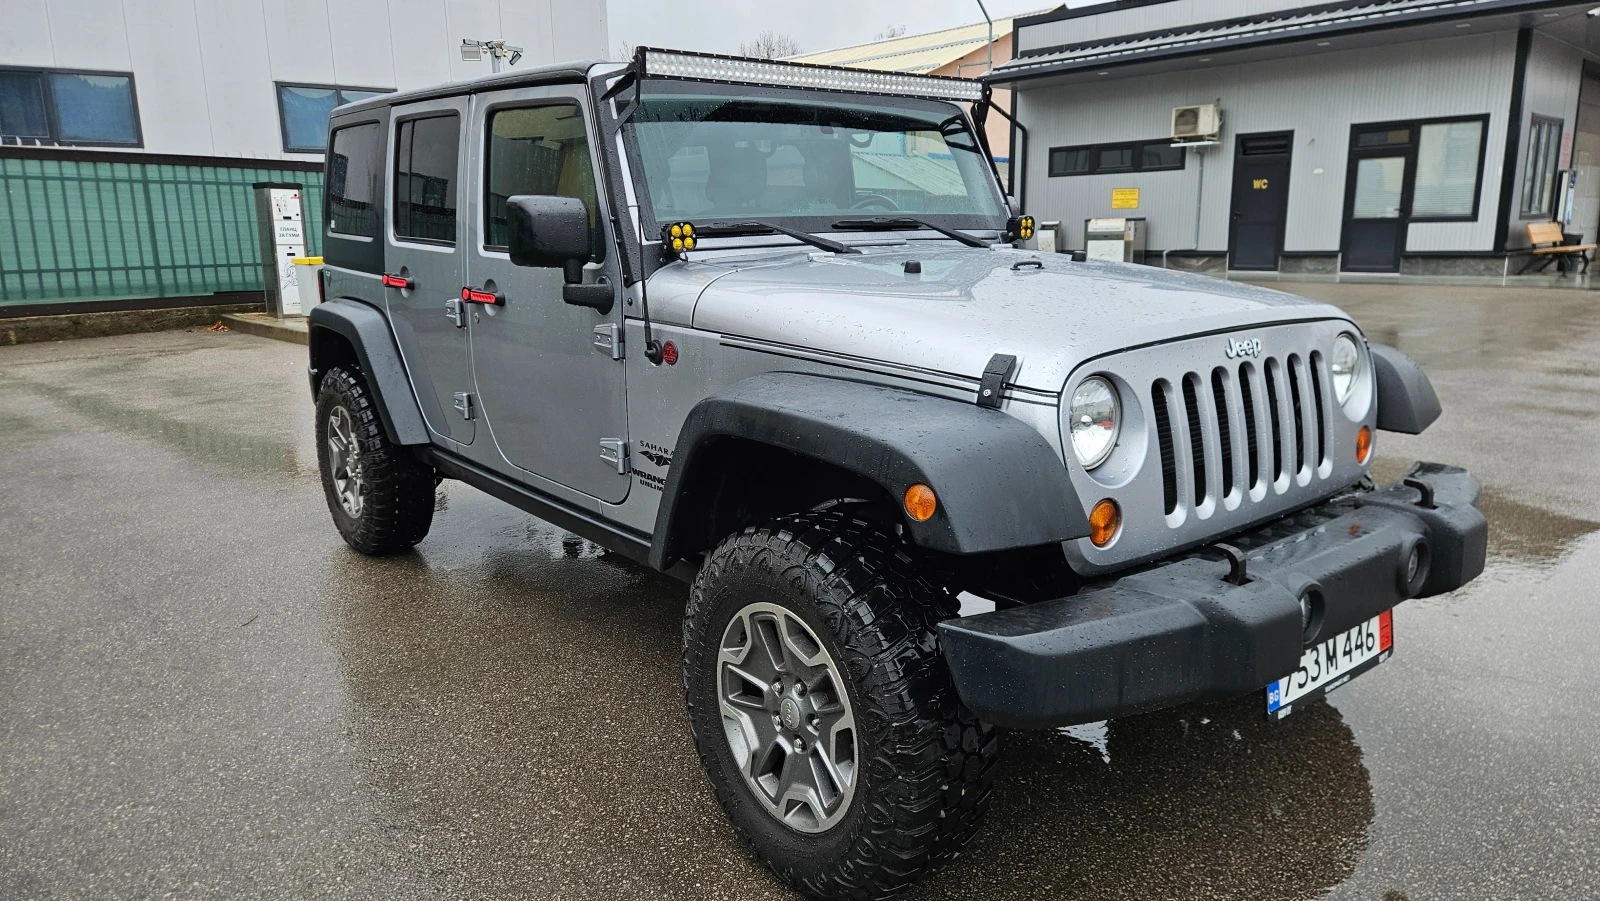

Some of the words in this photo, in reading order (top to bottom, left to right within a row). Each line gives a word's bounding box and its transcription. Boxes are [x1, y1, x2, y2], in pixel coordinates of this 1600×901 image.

[1253, 178, 1268, 189] WC
[1225, 337, 1262, 360] Jeep
[1269, 689, 1279, 705] BG
